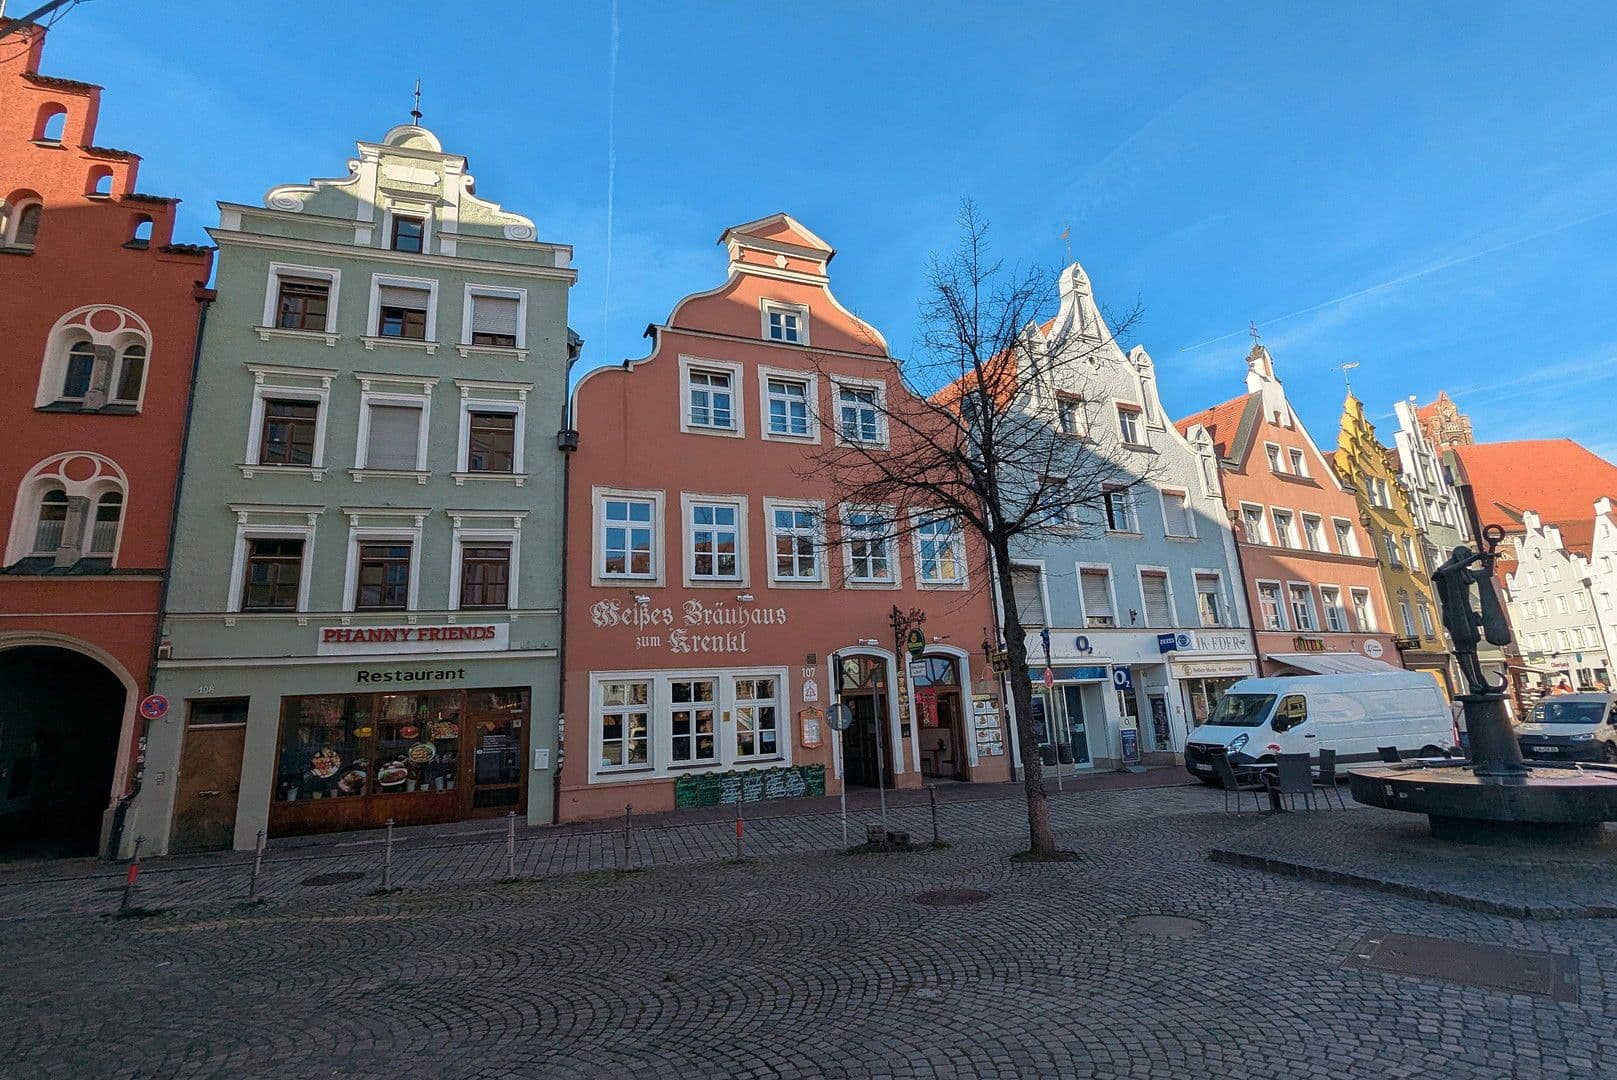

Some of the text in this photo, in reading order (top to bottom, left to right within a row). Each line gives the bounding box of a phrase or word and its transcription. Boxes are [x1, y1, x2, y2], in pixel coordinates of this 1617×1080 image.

[591, 598, 787, 632] Weißes Bräuhaus
[323, 625, 496, 644] PHANNY FRIENDS
[636, 627, 749, 654] zum Krenkl
[357, 668, 466, 683] Restaurant
[801, 667, 816, 678] 107
